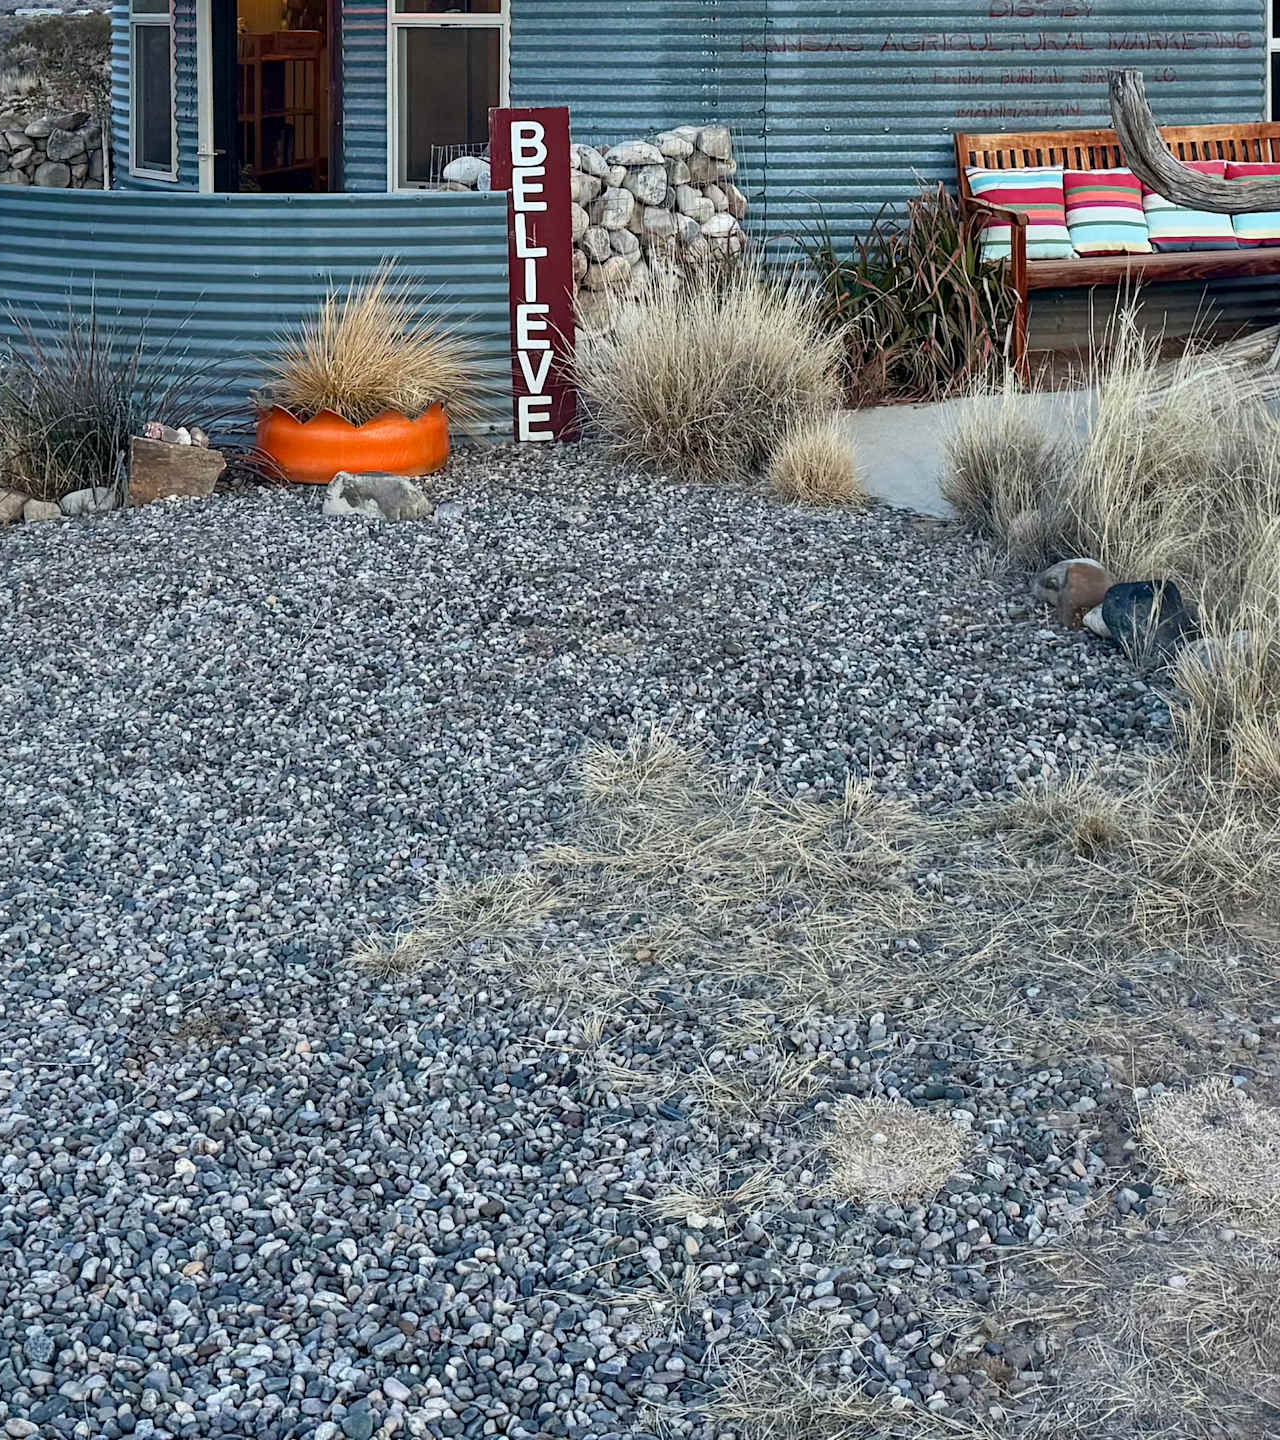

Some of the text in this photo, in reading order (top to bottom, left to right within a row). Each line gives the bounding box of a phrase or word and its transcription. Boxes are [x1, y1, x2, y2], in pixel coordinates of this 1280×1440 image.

[740, 31, 1252, 52] KANSAS AGRICULTURAL MARKETING
[510, 121, 554, 441] BELIEVE
